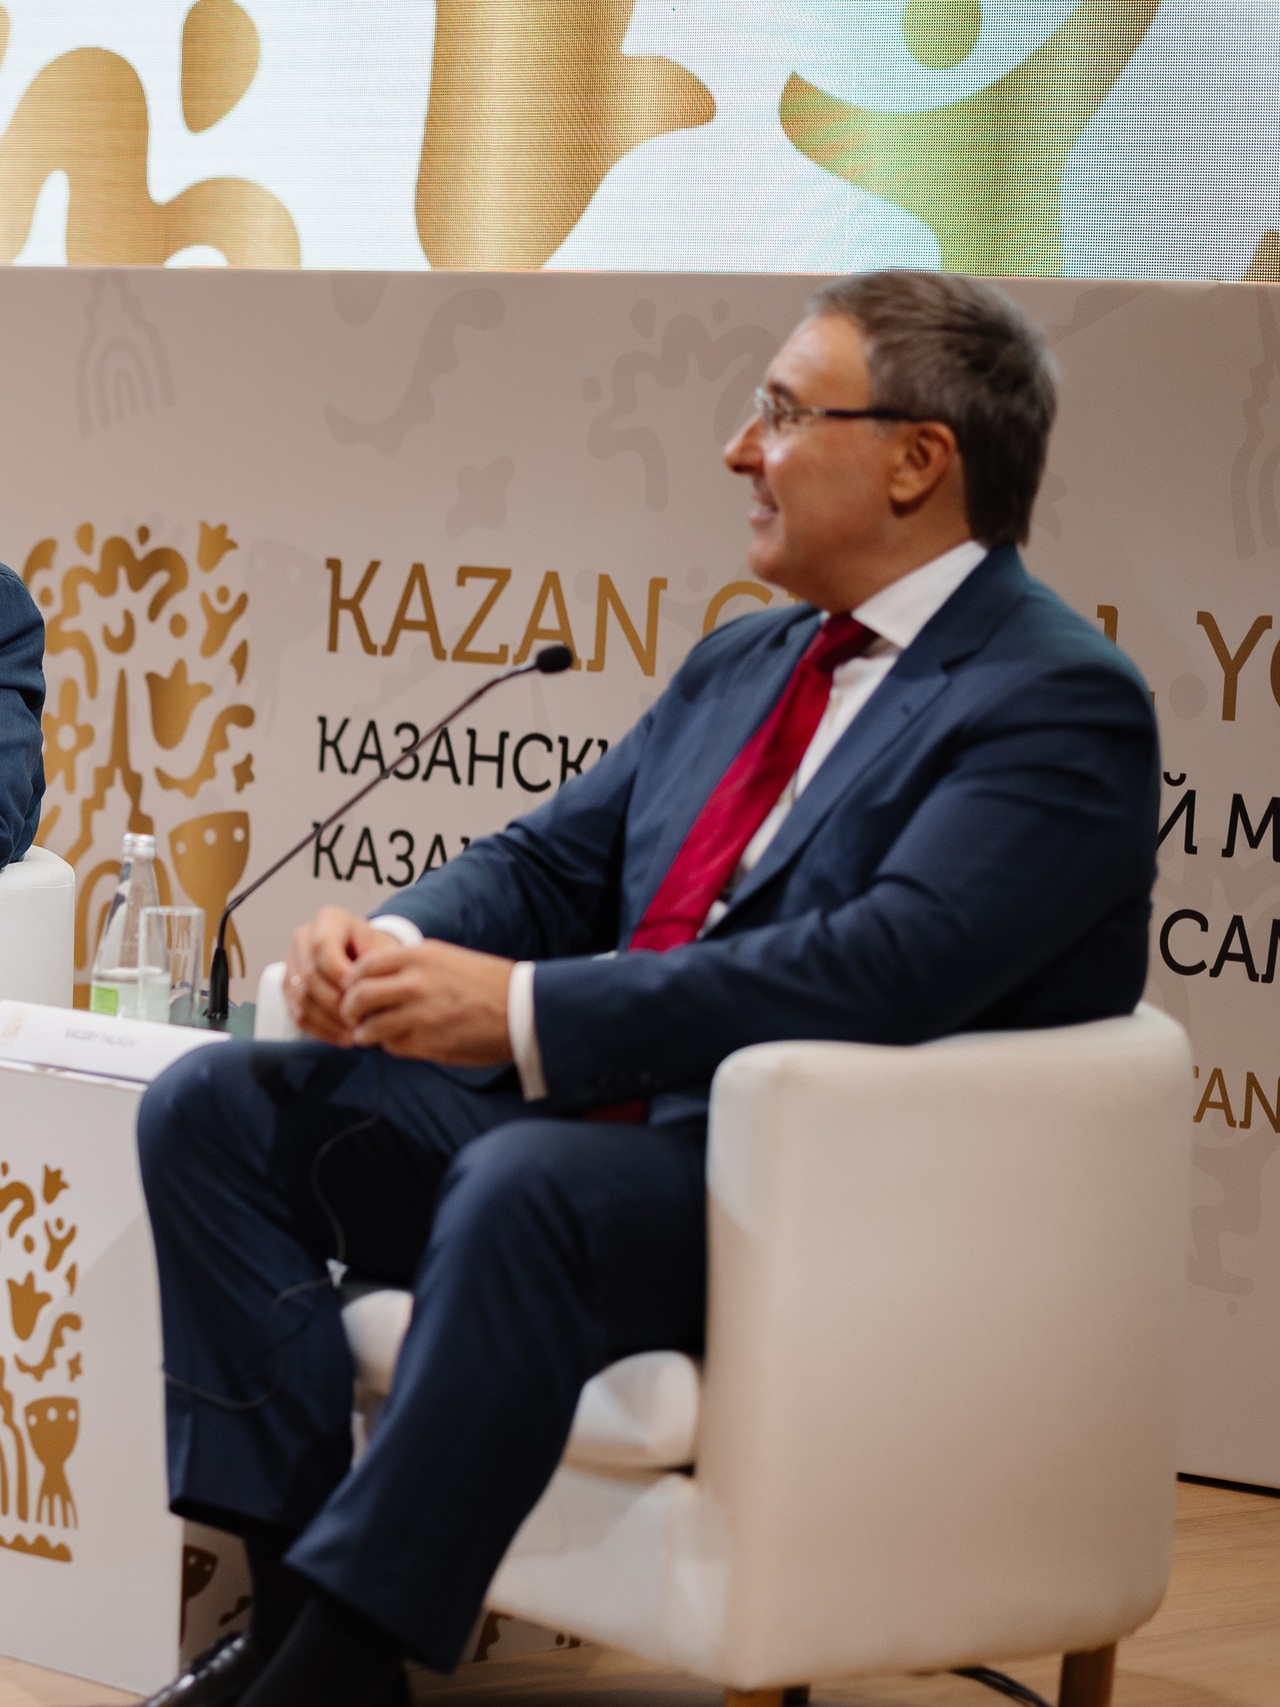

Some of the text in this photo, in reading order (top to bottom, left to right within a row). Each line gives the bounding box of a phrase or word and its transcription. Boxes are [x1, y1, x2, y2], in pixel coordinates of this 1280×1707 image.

[325, 557, 668, 678] KAZAN
[1195, 610, 1280, 722] Y
[317, 715, 609, 793] КАЗАНСК
[311, 821, 1280, 985] КАЗА СА
[1192, 1064, 1280, 1134] AN
